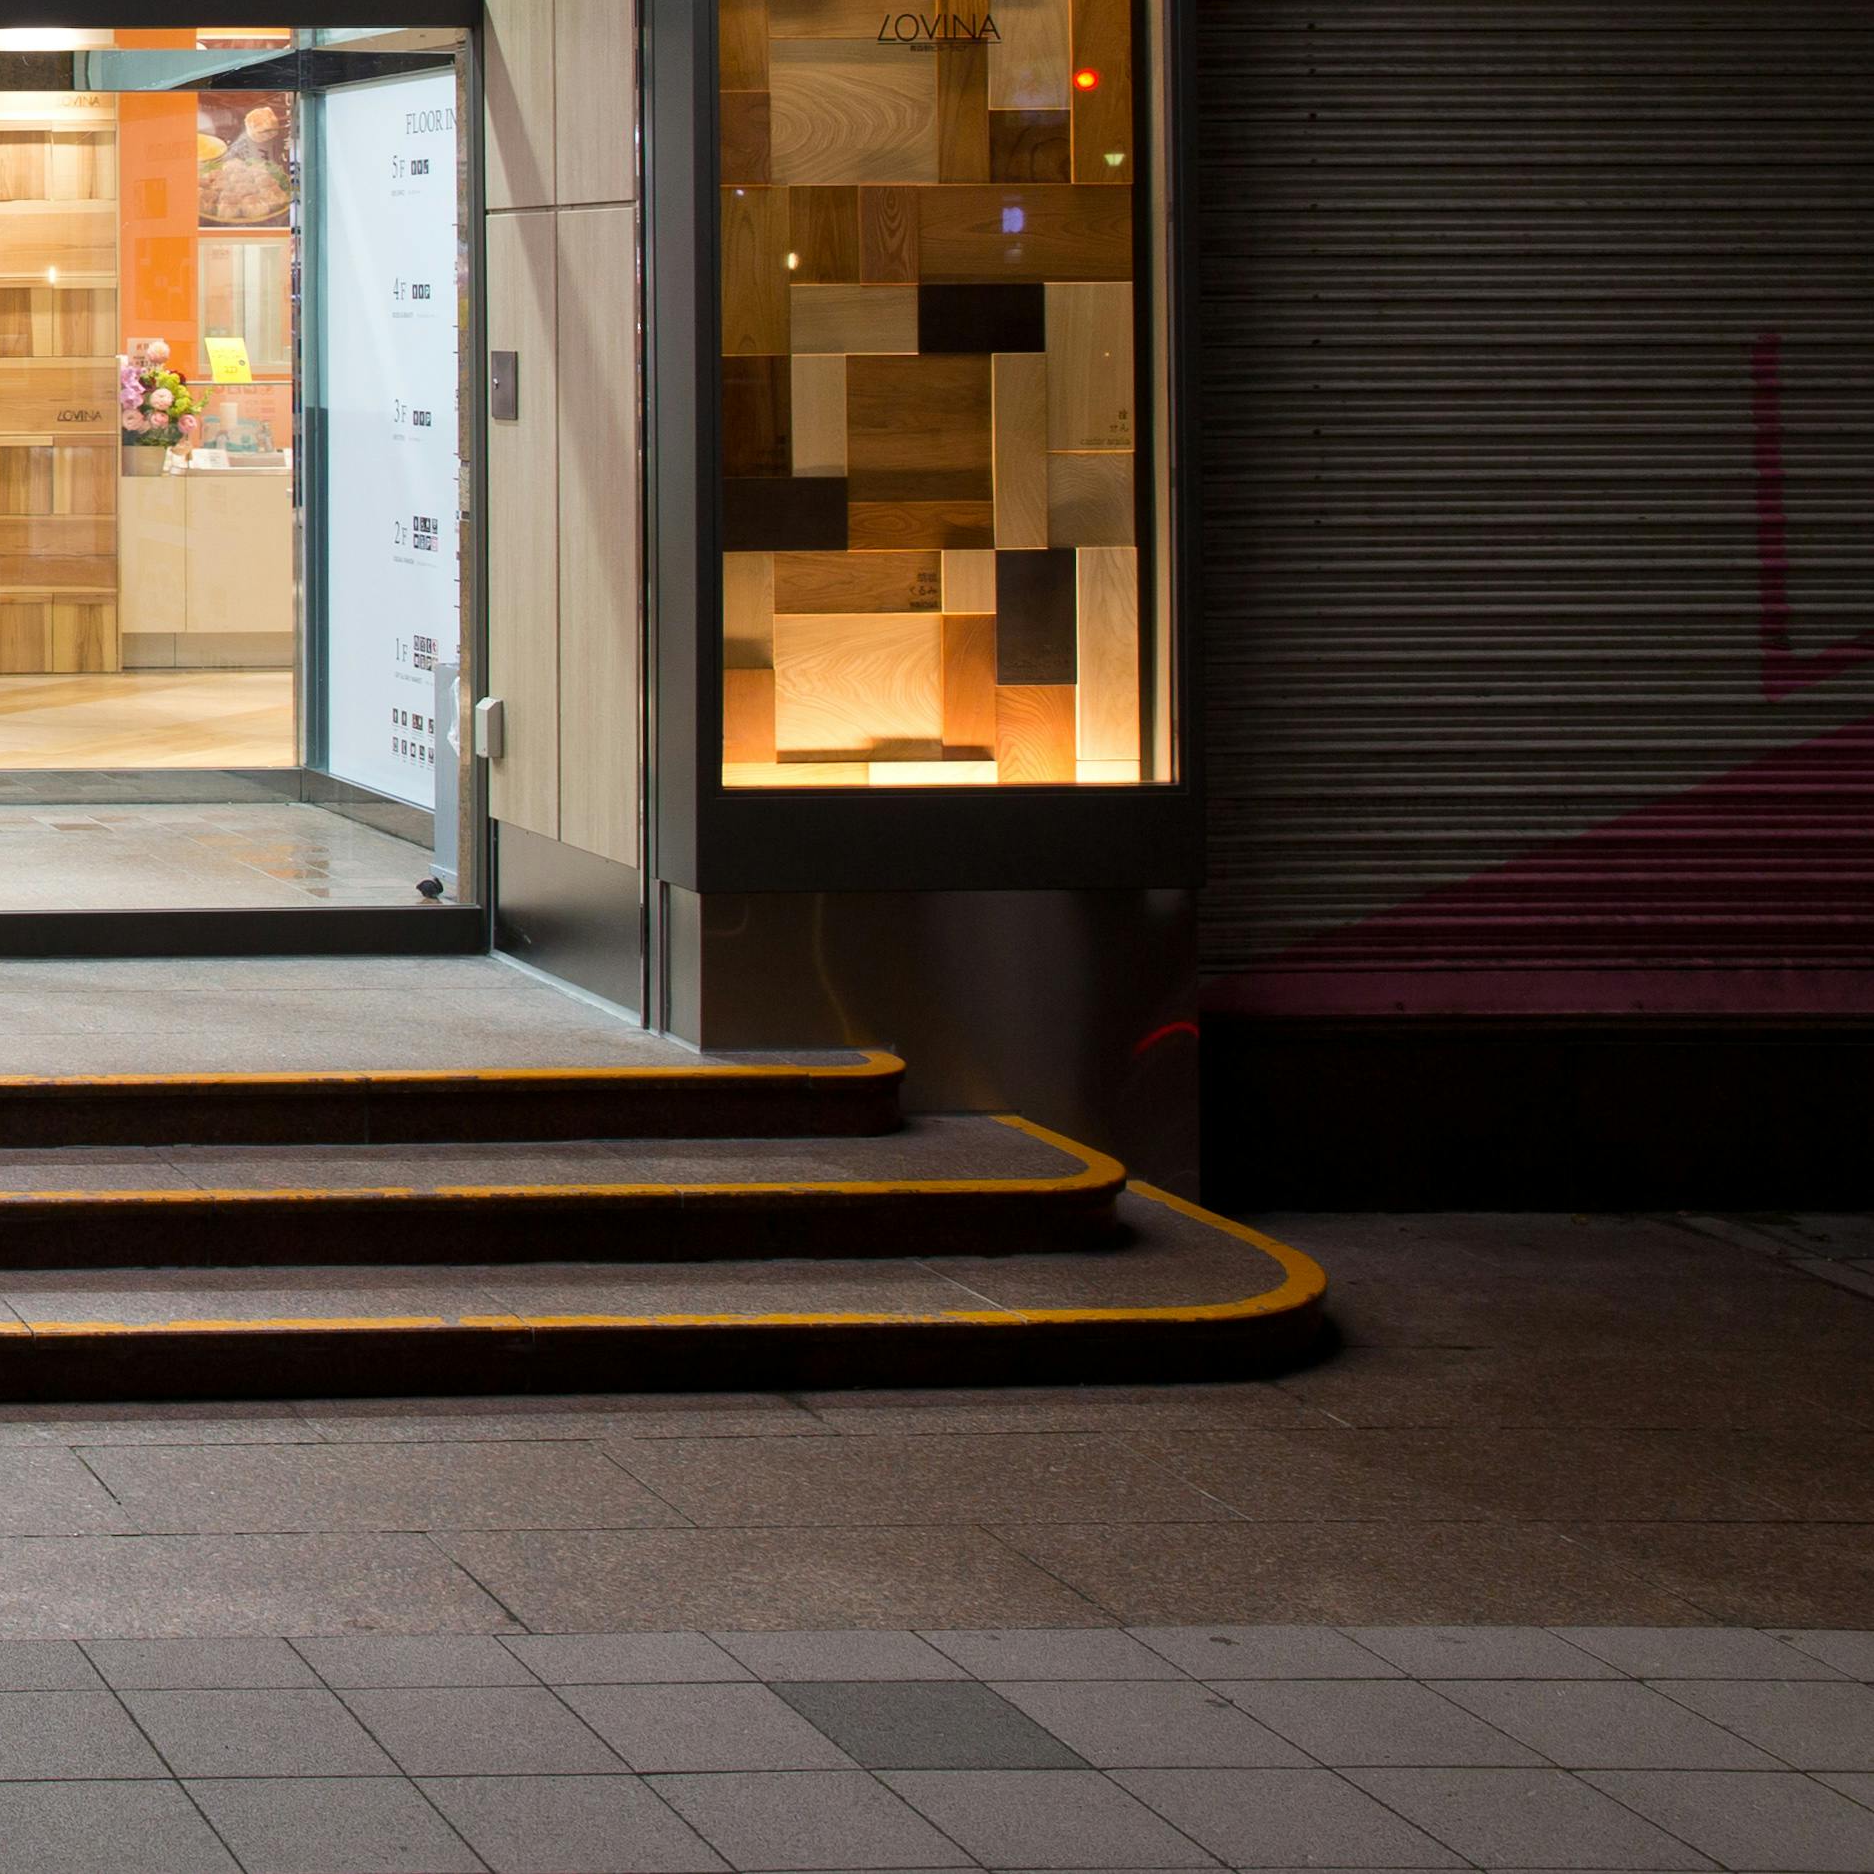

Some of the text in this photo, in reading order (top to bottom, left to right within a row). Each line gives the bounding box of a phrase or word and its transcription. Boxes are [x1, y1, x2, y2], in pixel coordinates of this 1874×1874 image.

[877, 13, 1002, 43] LOVINA
[405, 107, 458, 135] FLOOR IN
[392, 154, 406, 179] 5F
[393, 277, 407, 301] 4F
[56, 409, 102, 423] LOVINA
[393, 398, 407, 423] 3F
[393, 520, 408, 545] 2F
[395, 637, 409, 663] 1F
